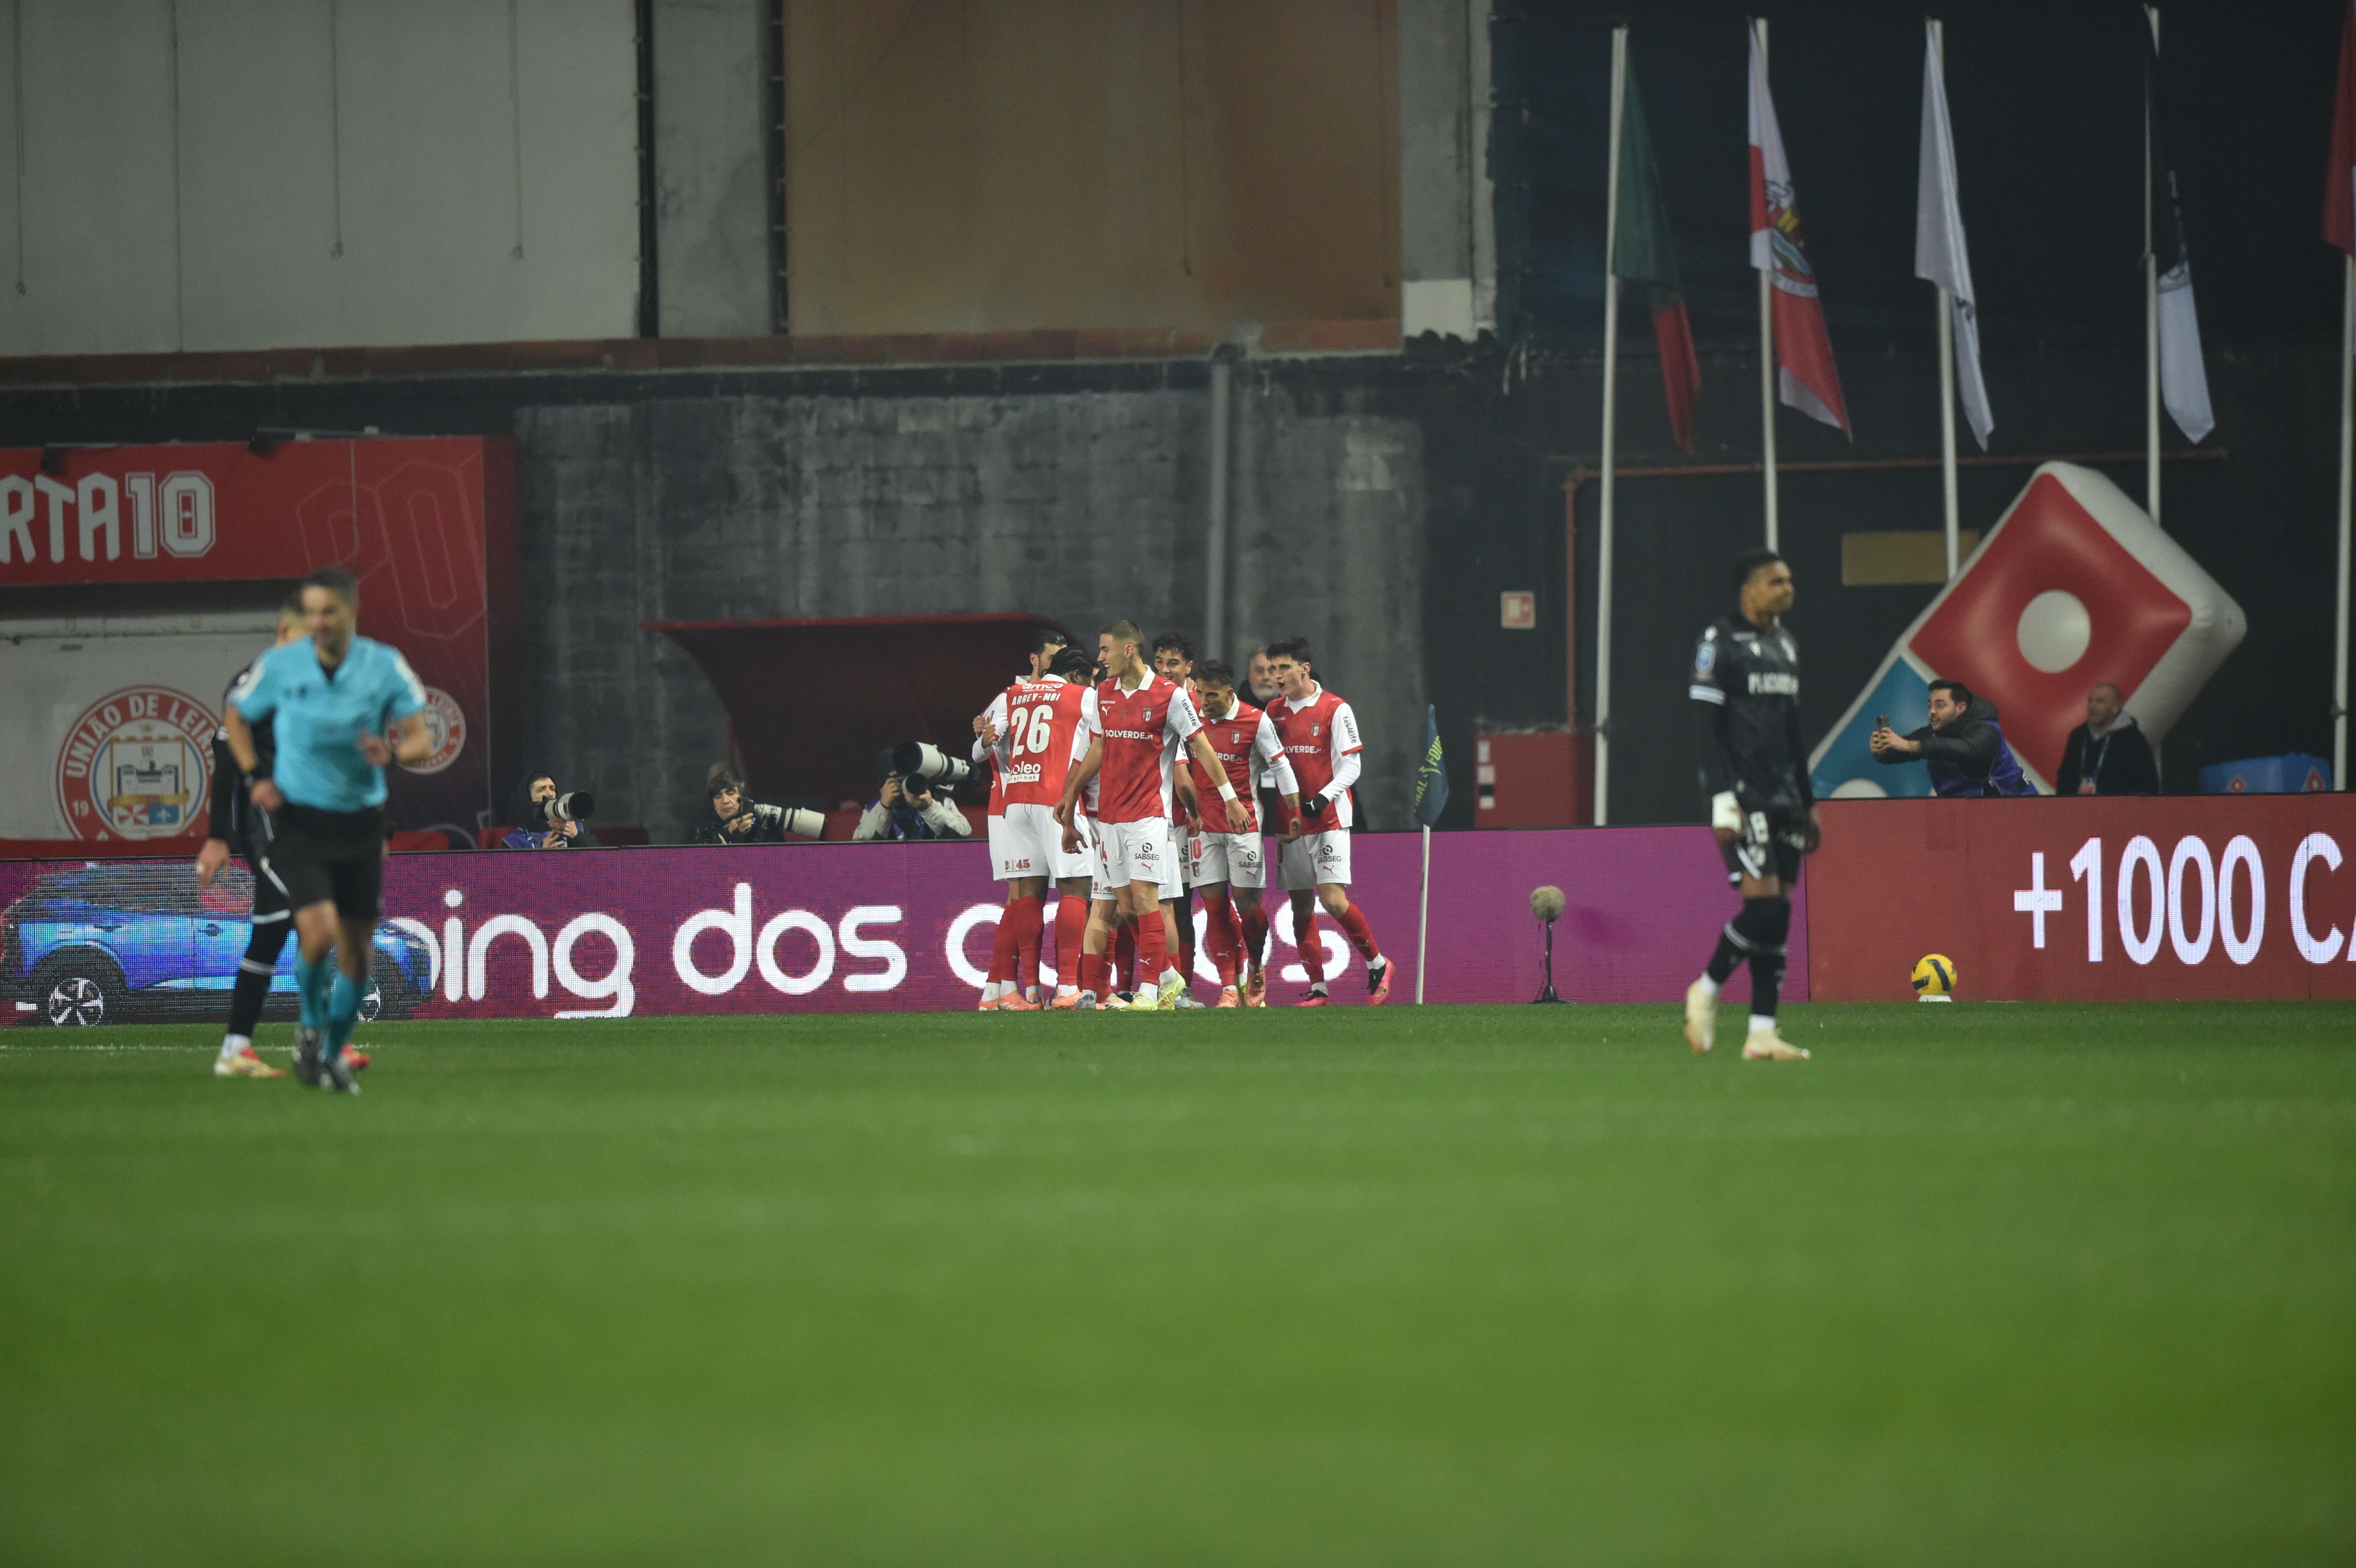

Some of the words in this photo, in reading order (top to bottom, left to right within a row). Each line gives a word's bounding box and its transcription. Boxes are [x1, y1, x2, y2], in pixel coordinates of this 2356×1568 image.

[128, 694, 159, 717] DE
[1011, 693, 1061, 706] ARREY-MBI
[1181, 698, 1196, 727] tek4life
[1011, 704, 1054, 759] 26
[1105, 730, 1153, 740] SOLVERDE.PT
[1343, 716, 1357, 744] tek4life
[1011, 761, 1041, 774] oleo
[1190, 838, 1202, 860] 10
[1318, 855, 1342, 864] SABSEG
[2013, 835, 2266, 965] +1000
[2290, 832, 2356, 965] C
[672, 882, 908, 996] dos
